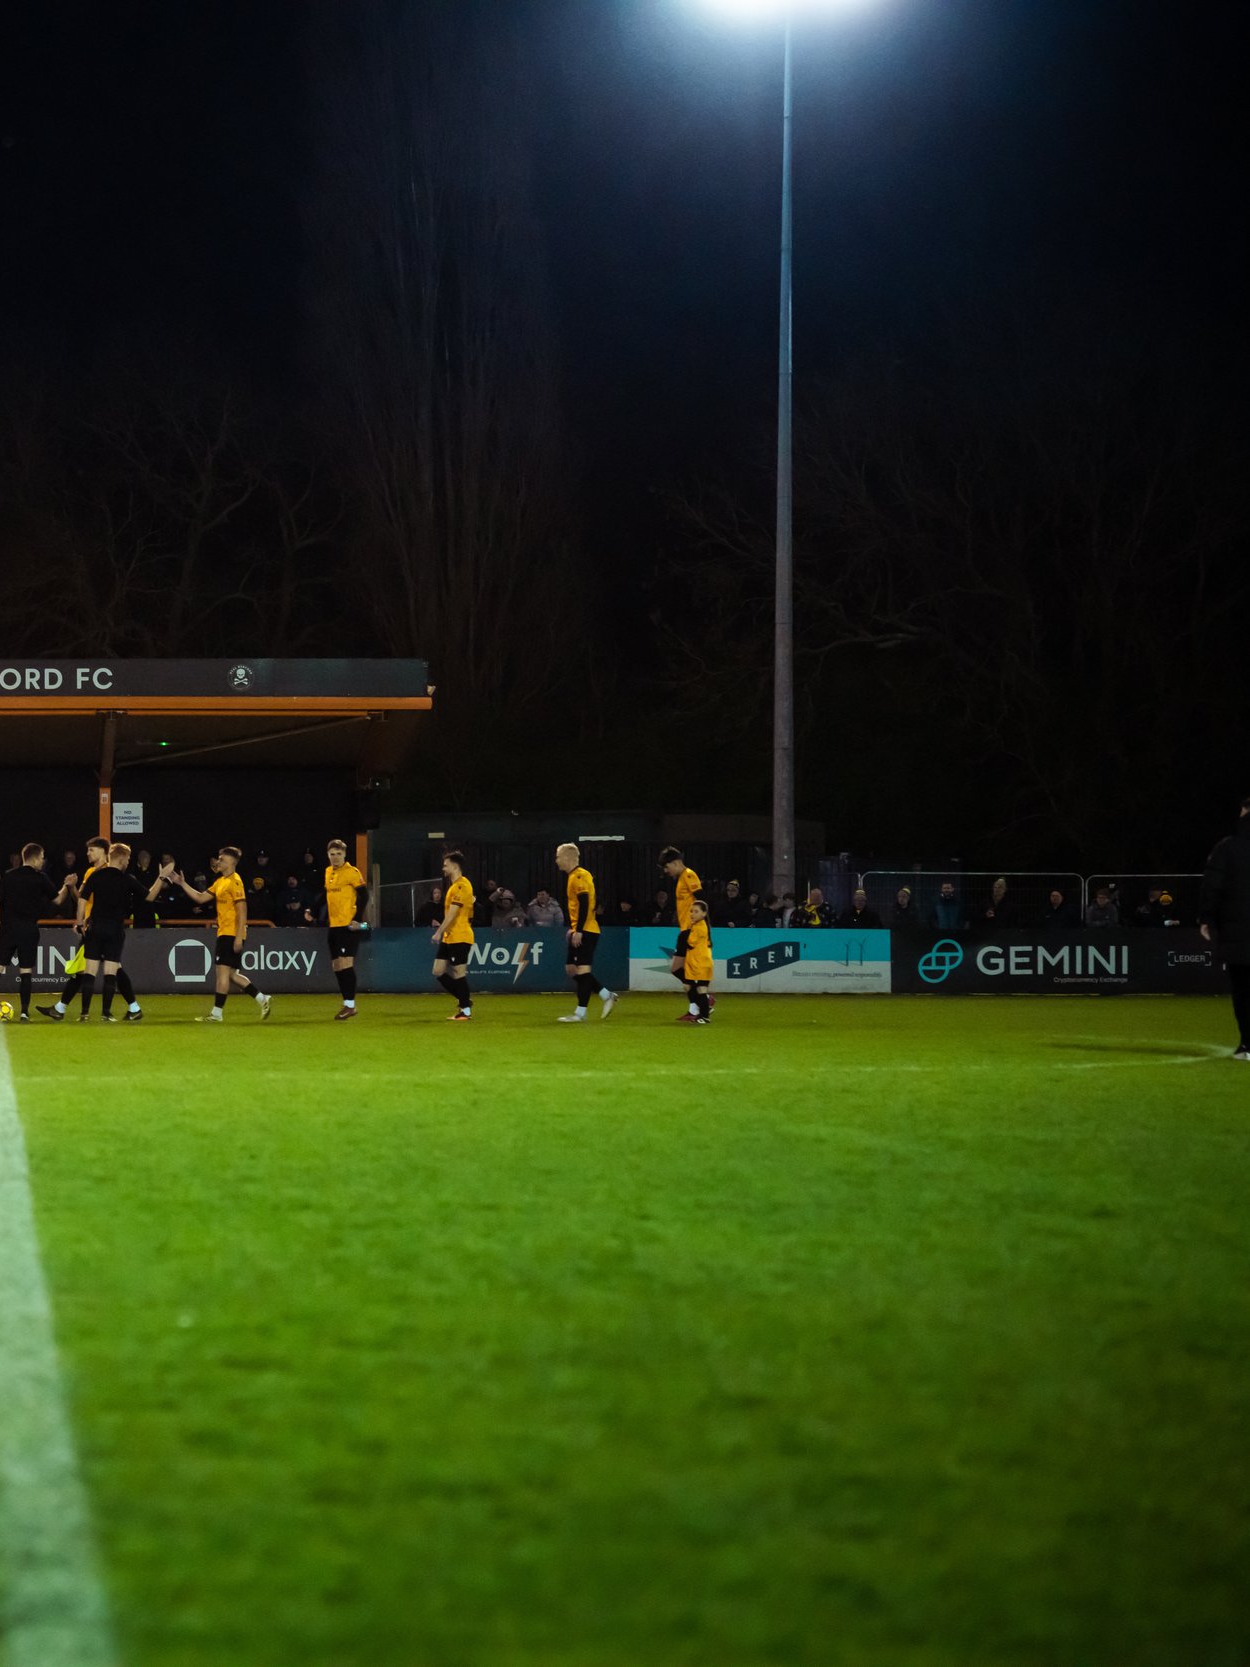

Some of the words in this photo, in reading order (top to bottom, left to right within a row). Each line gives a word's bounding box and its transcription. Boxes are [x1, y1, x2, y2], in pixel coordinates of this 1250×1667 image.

[76, 667, 113, 690] FC
[240, 944, 317, 976] alaxy
[732, 945, 793, 975] IREN
[976, 945, 1129, 976] GEMINI
[1174, 954, 1206, 963] LEDGER
